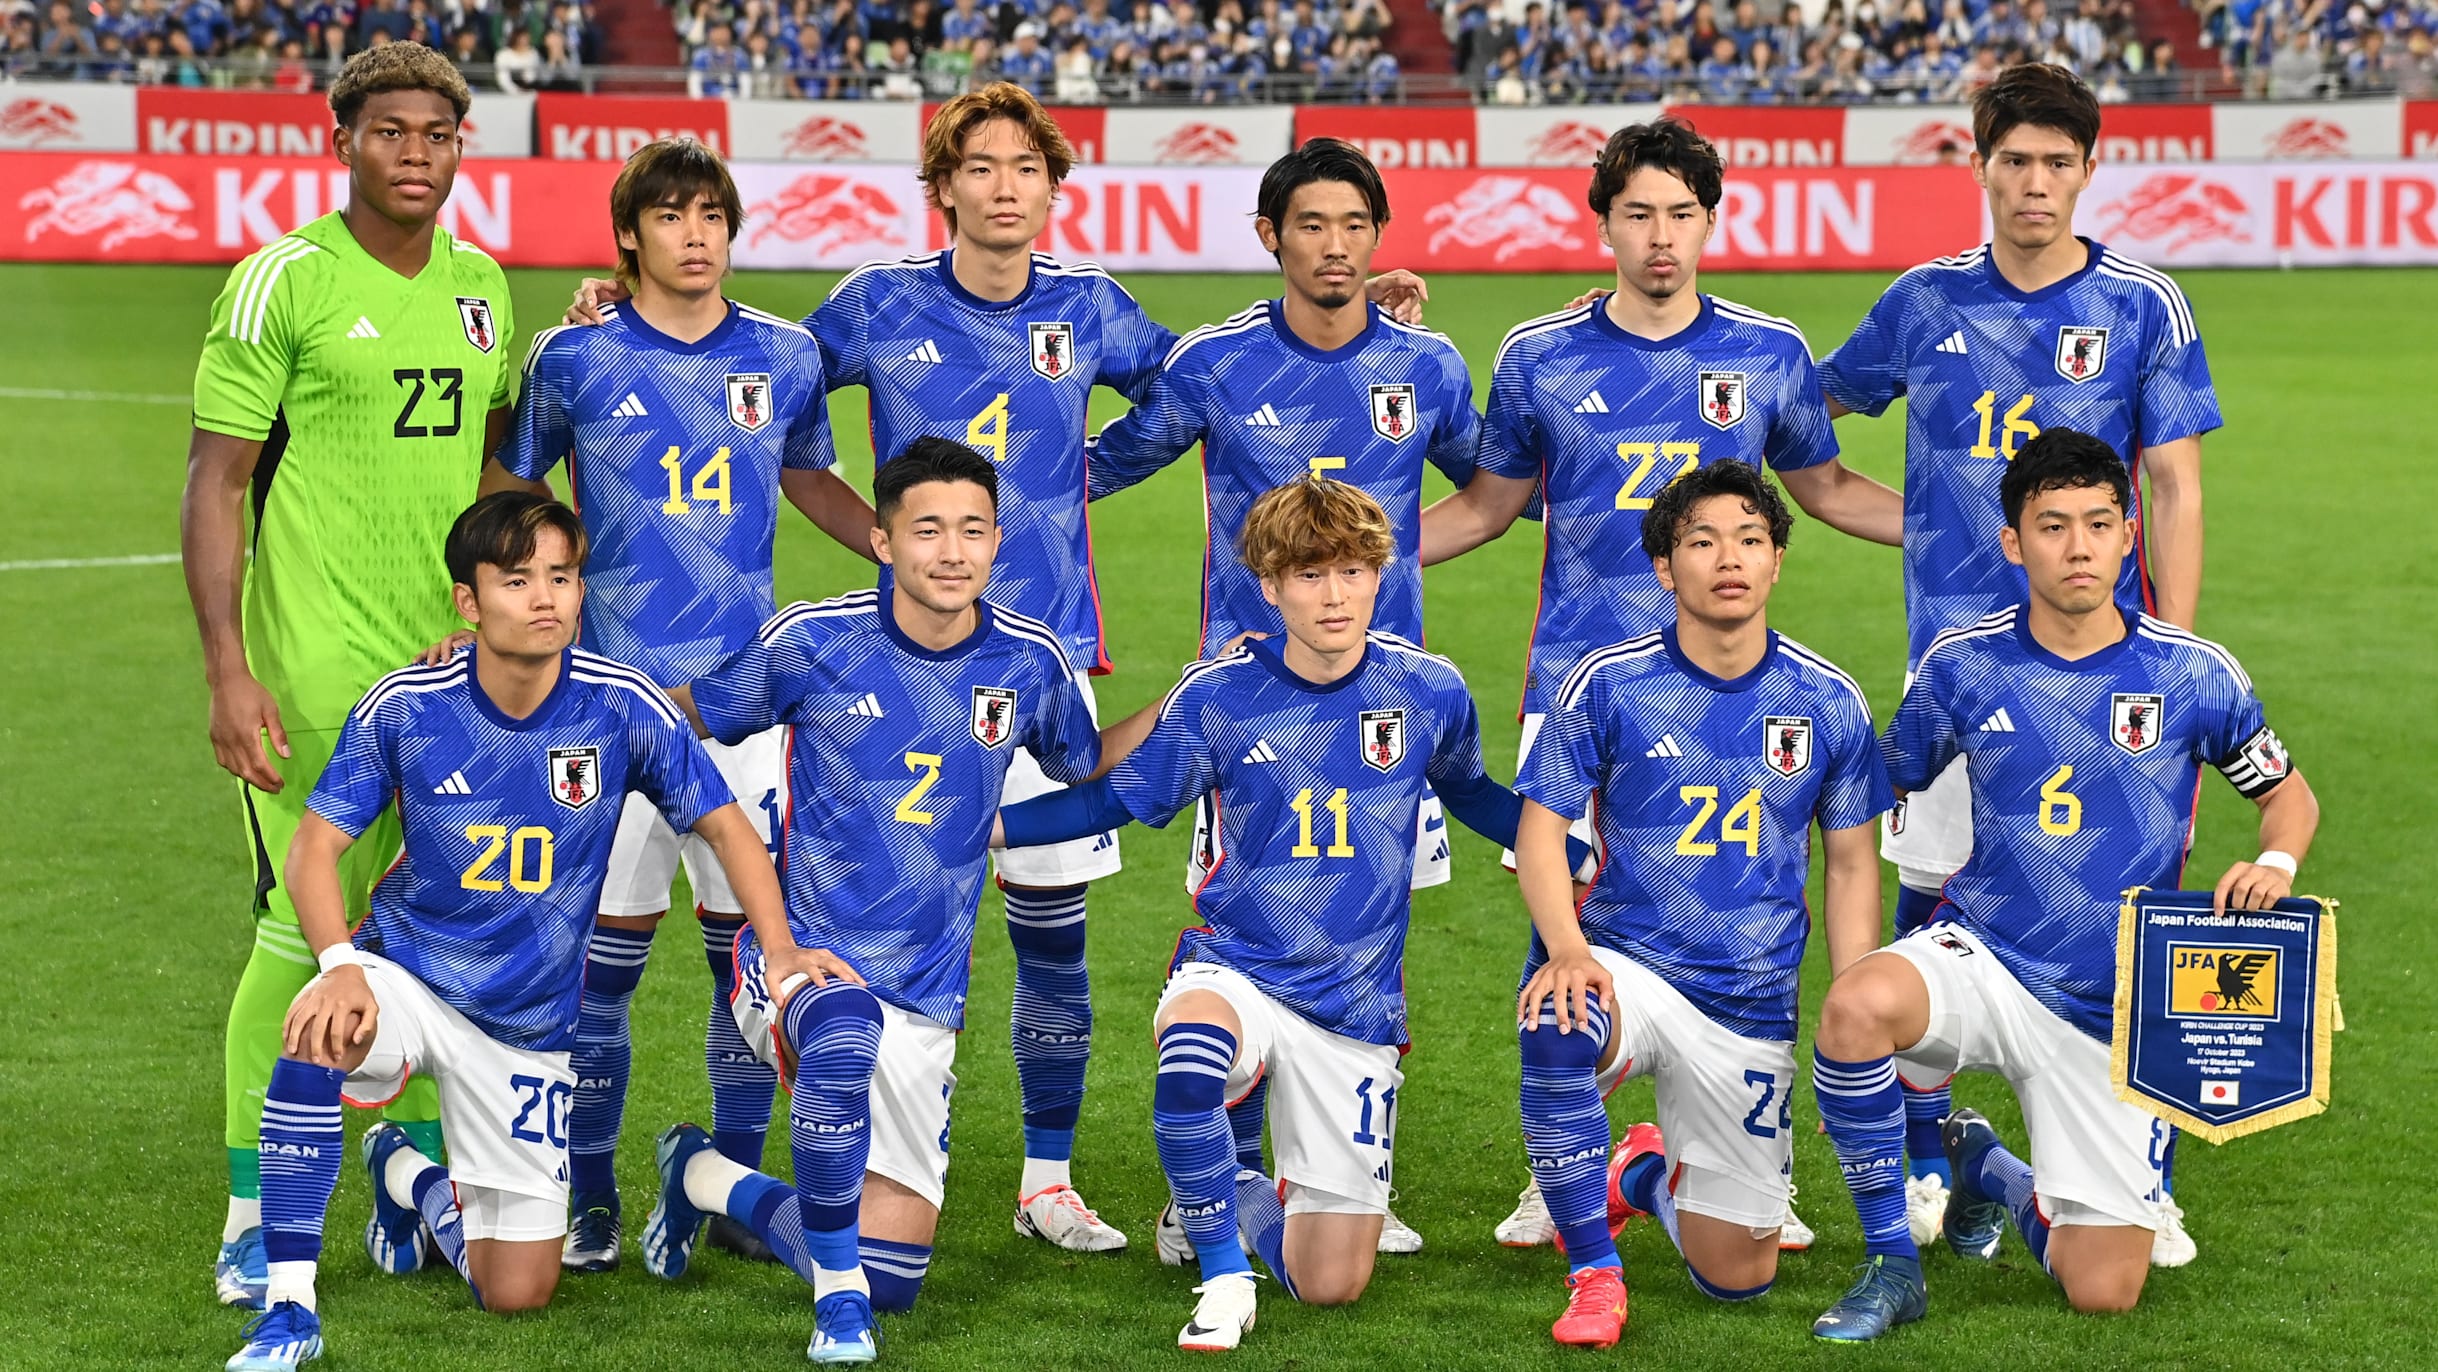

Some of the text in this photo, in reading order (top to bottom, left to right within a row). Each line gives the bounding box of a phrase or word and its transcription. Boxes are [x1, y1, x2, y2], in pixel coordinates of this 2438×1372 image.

[1353, 138, 1469, 168] RIN
[216, 169, 512, 250] KIN
[2073, 327, 2096, 335] JAPAN
[1045, 361, 1063, 371] JFA
[2069, 364, 2089, 374] JFA
[393, 368, 462, 438] 23
[742, 413, 760, 422] JFA
[1714, 410, 1732, 419] JFA
[966, 393, 1009, 462] 4
[1385, 424, 1404, 434] JFA
[1970, 391, 2042, 461] 16
[659, 446, 731, 515] 14
[984, 689, 1006, 697] JAPAN
[1776, 718, 1800, 726] JAPAN
[983, 729, 1000, 739] JFA
[2126, 734, 2145, 743] JFA
[560, 749, 586, 757] JAPAN
[1375, 751, 1395, 760] JFA
[1779, 758, 1798, 768] JFA
[565, 789, 587, 799] JFA
[895, 751, 942, 825] 2
[2038, 765, 2081, 836] 6
[759, 787, 779, 853] 1
[1290, 788, 1354, 857] 11
[1676, 785, 1761, 856] 24
[461, 825, 554, 894] 20
[2148, 912, 2305, 933] Japan Football Association
[2176, 952, 2216, 969] JFA
[2181, 1032, 2263, 1046] Japan vs. Tunisia
[510, 1073, 573, 1150] 20
[792, 1116, 864, 1134] JAPAN
[257, 1142, 320, 1158] PAN
[1175, 1200, 1227, 1218] APAN
